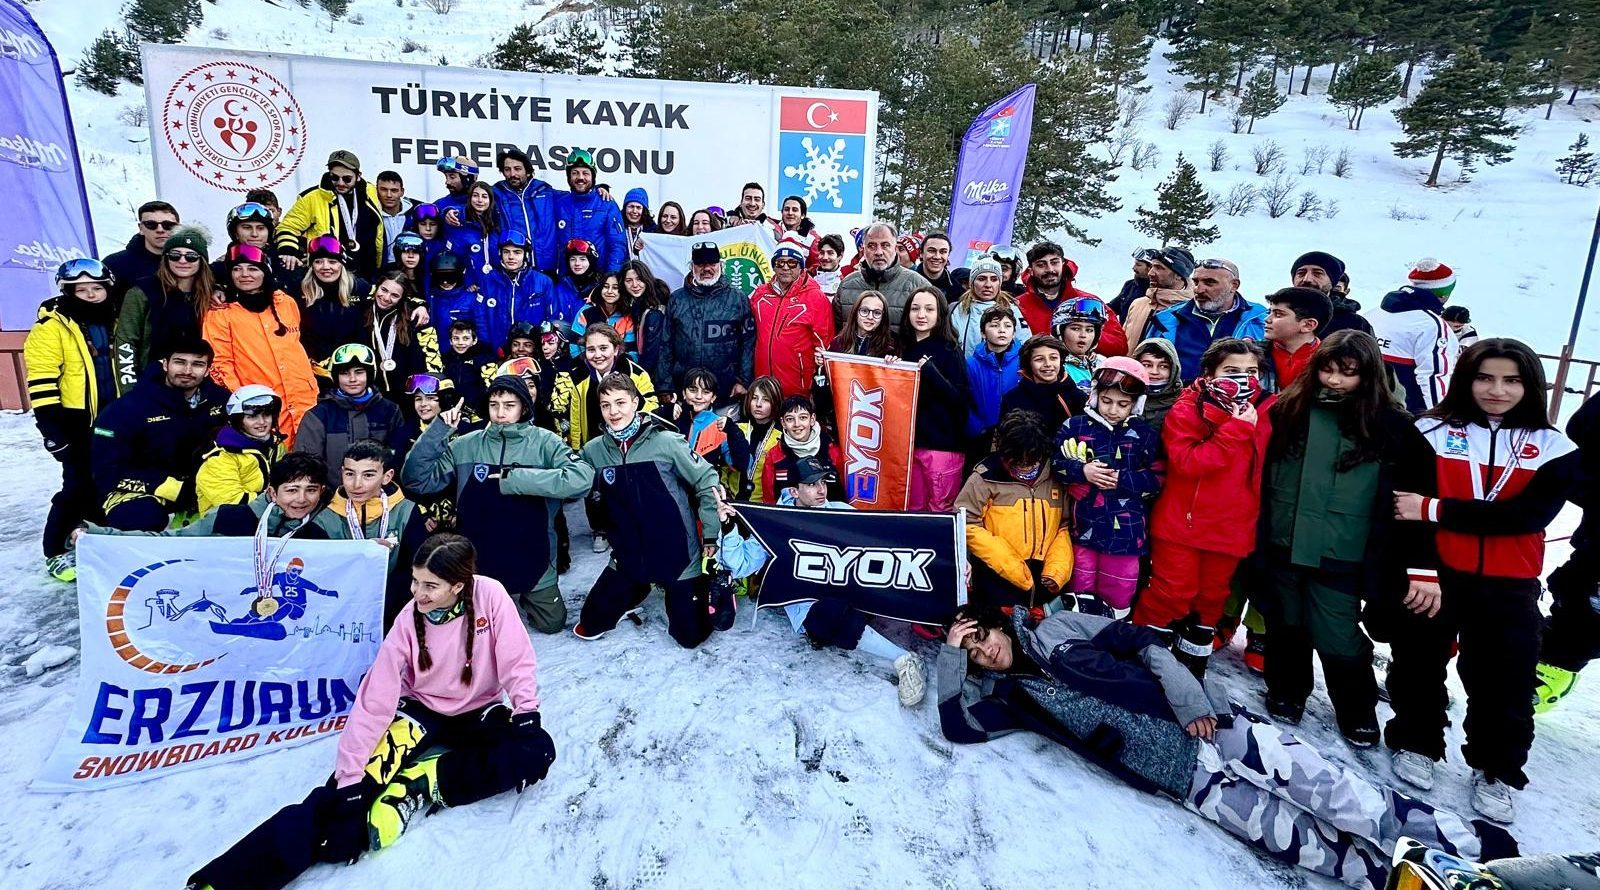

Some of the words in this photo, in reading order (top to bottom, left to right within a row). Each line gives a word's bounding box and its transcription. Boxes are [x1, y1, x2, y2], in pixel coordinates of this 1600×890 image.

[259, 98, 271, 109] VE
[268, 109, 281, 131] SPOR
[372, 83, 552, 123] TÜRKİYE
[566, 98, 690, 130] KAYAK
[964, 179, 1009, 199] Milka
[118, 343, 138, 385] PAKA
[1376, 337, 1391, 349] CE
[845, 378, 885, 505] EYOK
[789, 539, 935, 591] EYOK
[285, 586, 298, 597] 25
[73, 733, 260, 779] SNOWBOARD
[264, 715, 349, 745] KULÜB
